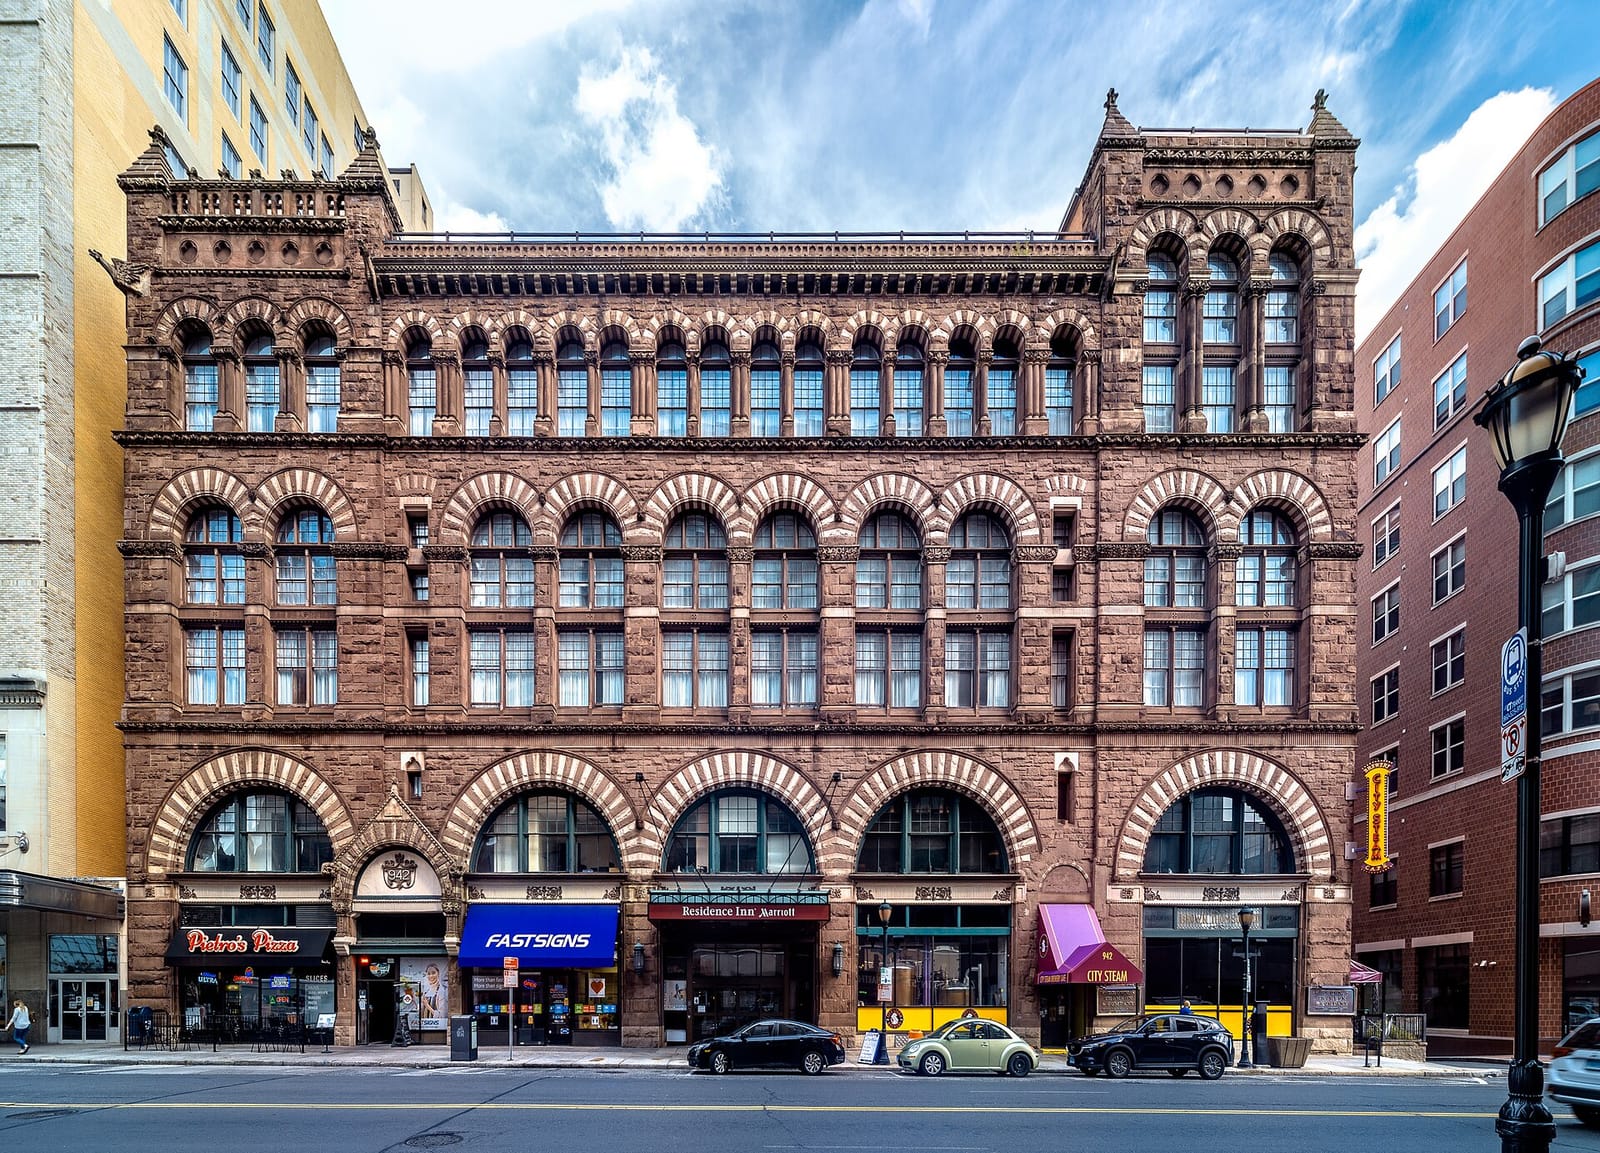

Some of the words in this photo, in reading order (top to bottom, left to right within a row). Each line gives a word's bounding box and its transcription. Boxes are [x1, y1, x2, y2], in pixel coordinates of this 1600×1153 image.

[1372, 773, 1382, 812] CITY
[1371, 813, 1382, 861] STEAM
[388, 869, 411, 880] 942
[682, 905, 734, 917] Residence
[735, 906, 755, 916] Inn
[759, 907, 796, 918] Marriott
[186, 929, 248, 953] Pietro's
[252, 929, 300, 953] Pizza
[485, 934, 591, 948] FASTSIGNS
[1102, 951, 1113, 960] 942
[198, 976, 218, 984] ULTRA
[1087, 970, 1103, 982] CITY
[1104, 970, 1128, 982] STEAM
